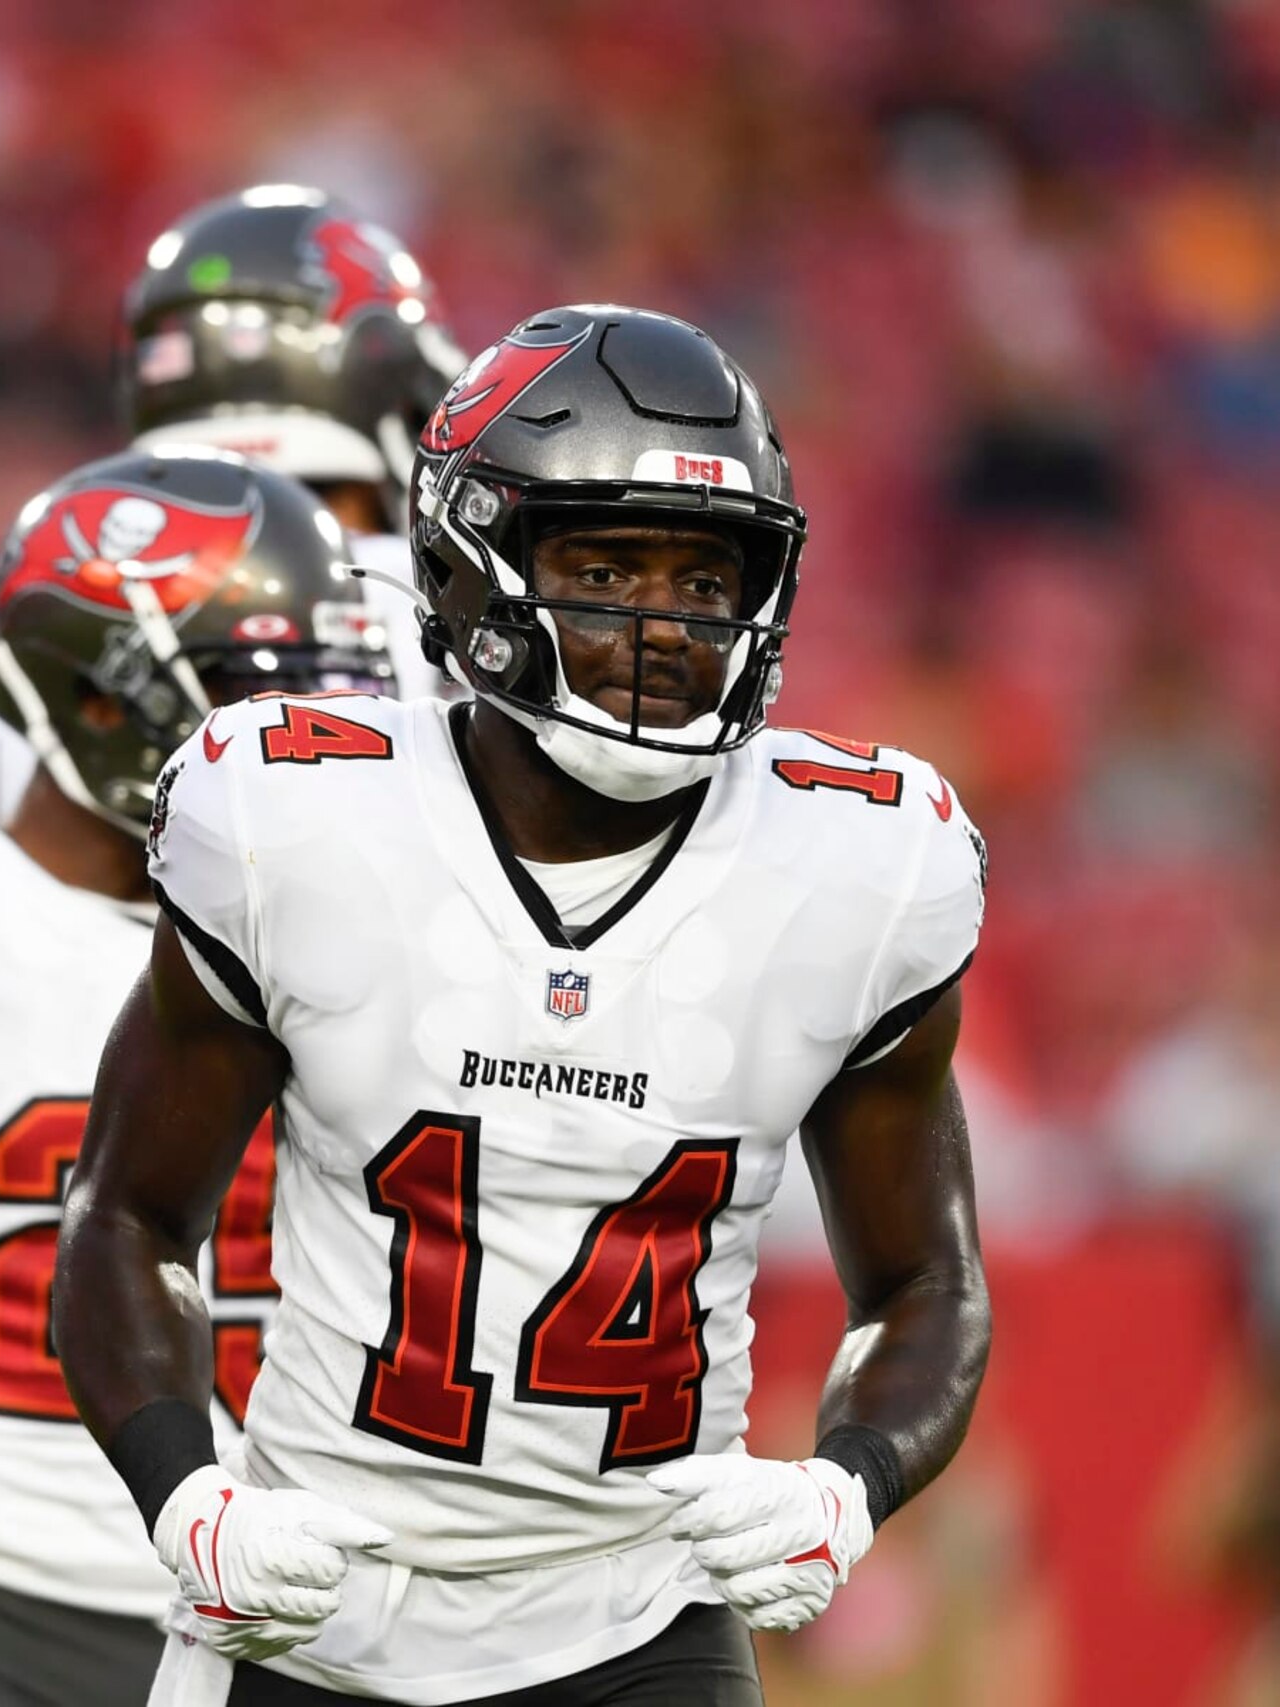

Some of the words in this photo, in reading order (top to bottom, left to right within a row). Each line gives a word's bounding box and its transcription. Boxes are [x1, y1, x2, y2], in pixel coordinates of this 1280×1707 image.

[674, 455, 723, 484] BUCS
[248, 688, 393, 765] 4
[551, 990, 584, 1015] NFL
[460, 1049, 648, 1109] BUCCANEERS
[352, 1109, 740, 1475] 14
